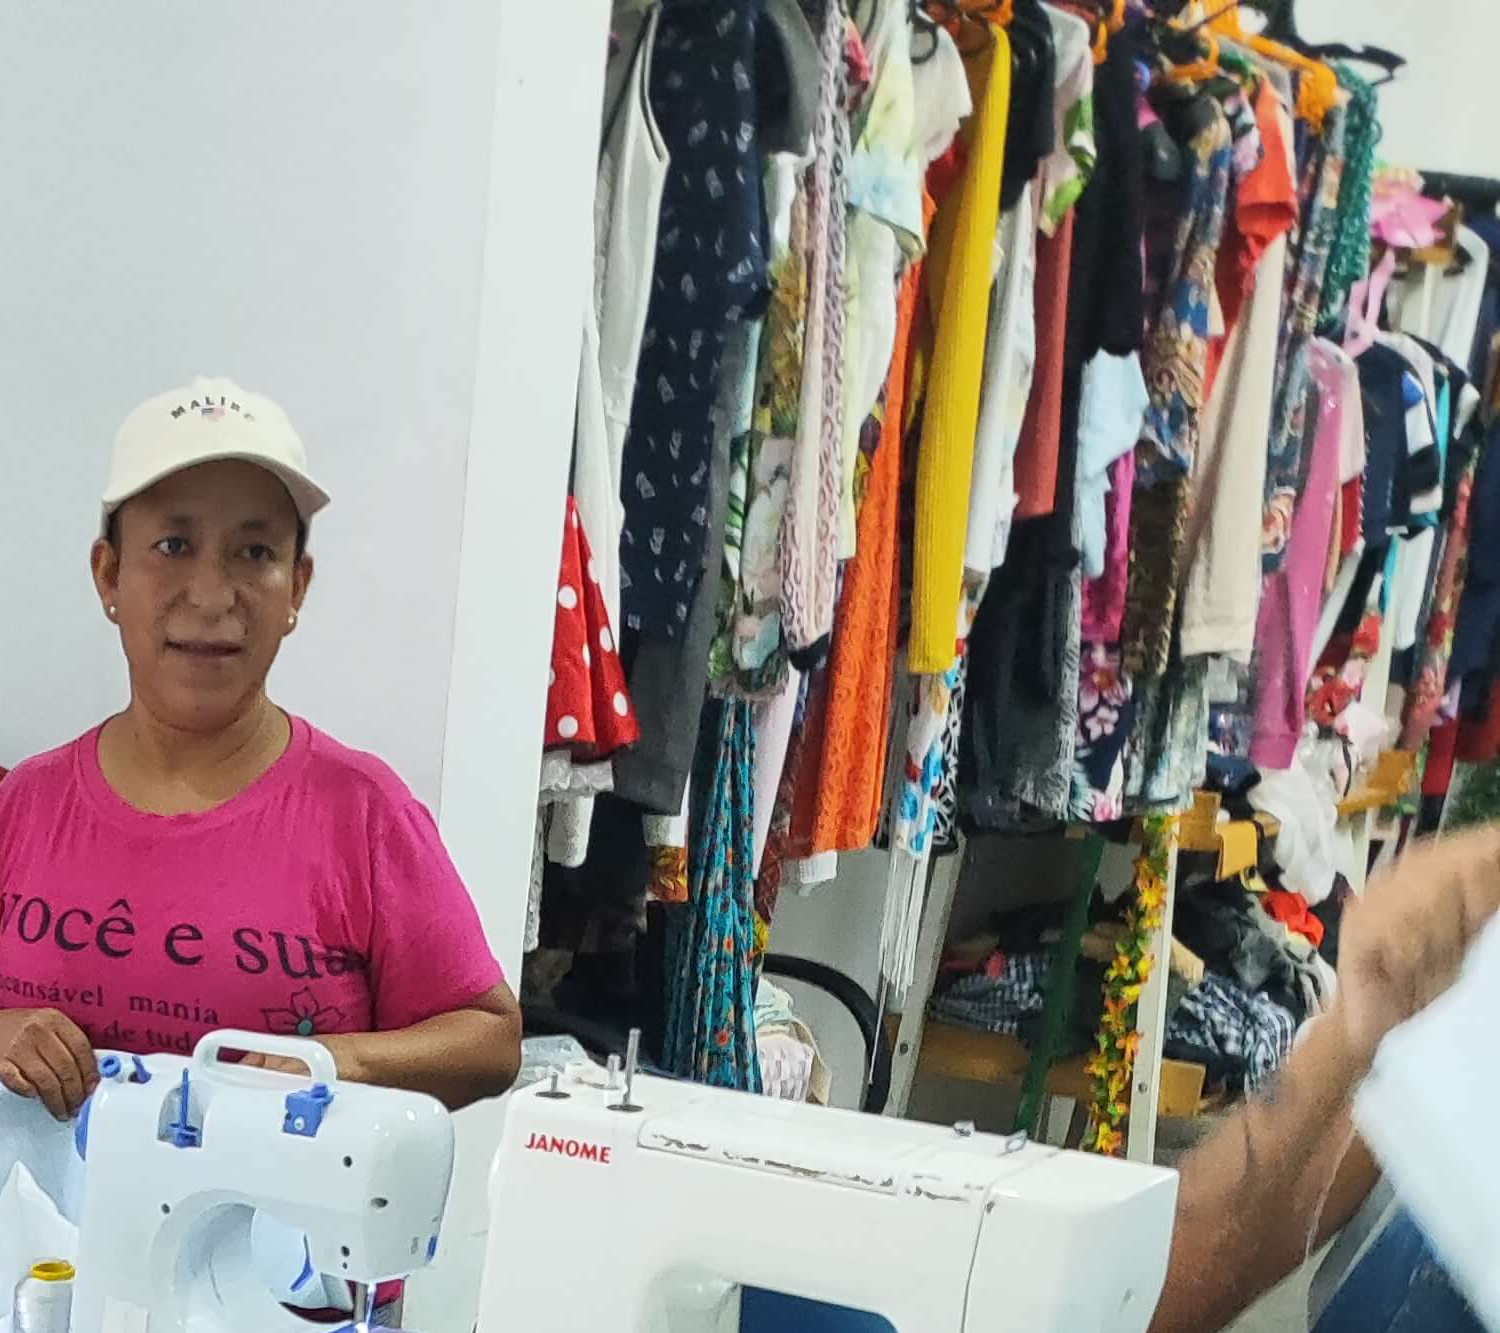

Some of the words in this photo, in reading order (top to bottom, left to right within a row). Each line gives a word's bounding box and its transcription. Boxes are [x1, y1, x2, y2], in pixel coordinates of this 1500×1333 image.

[164, 922, 204, 966] e
[0, 975, 104, 1007] cansável
[129, 994, 220, 1025] mania
[145, 1028, 194, 1053] tud
[524, 1132, 611, 1164] JANOME
